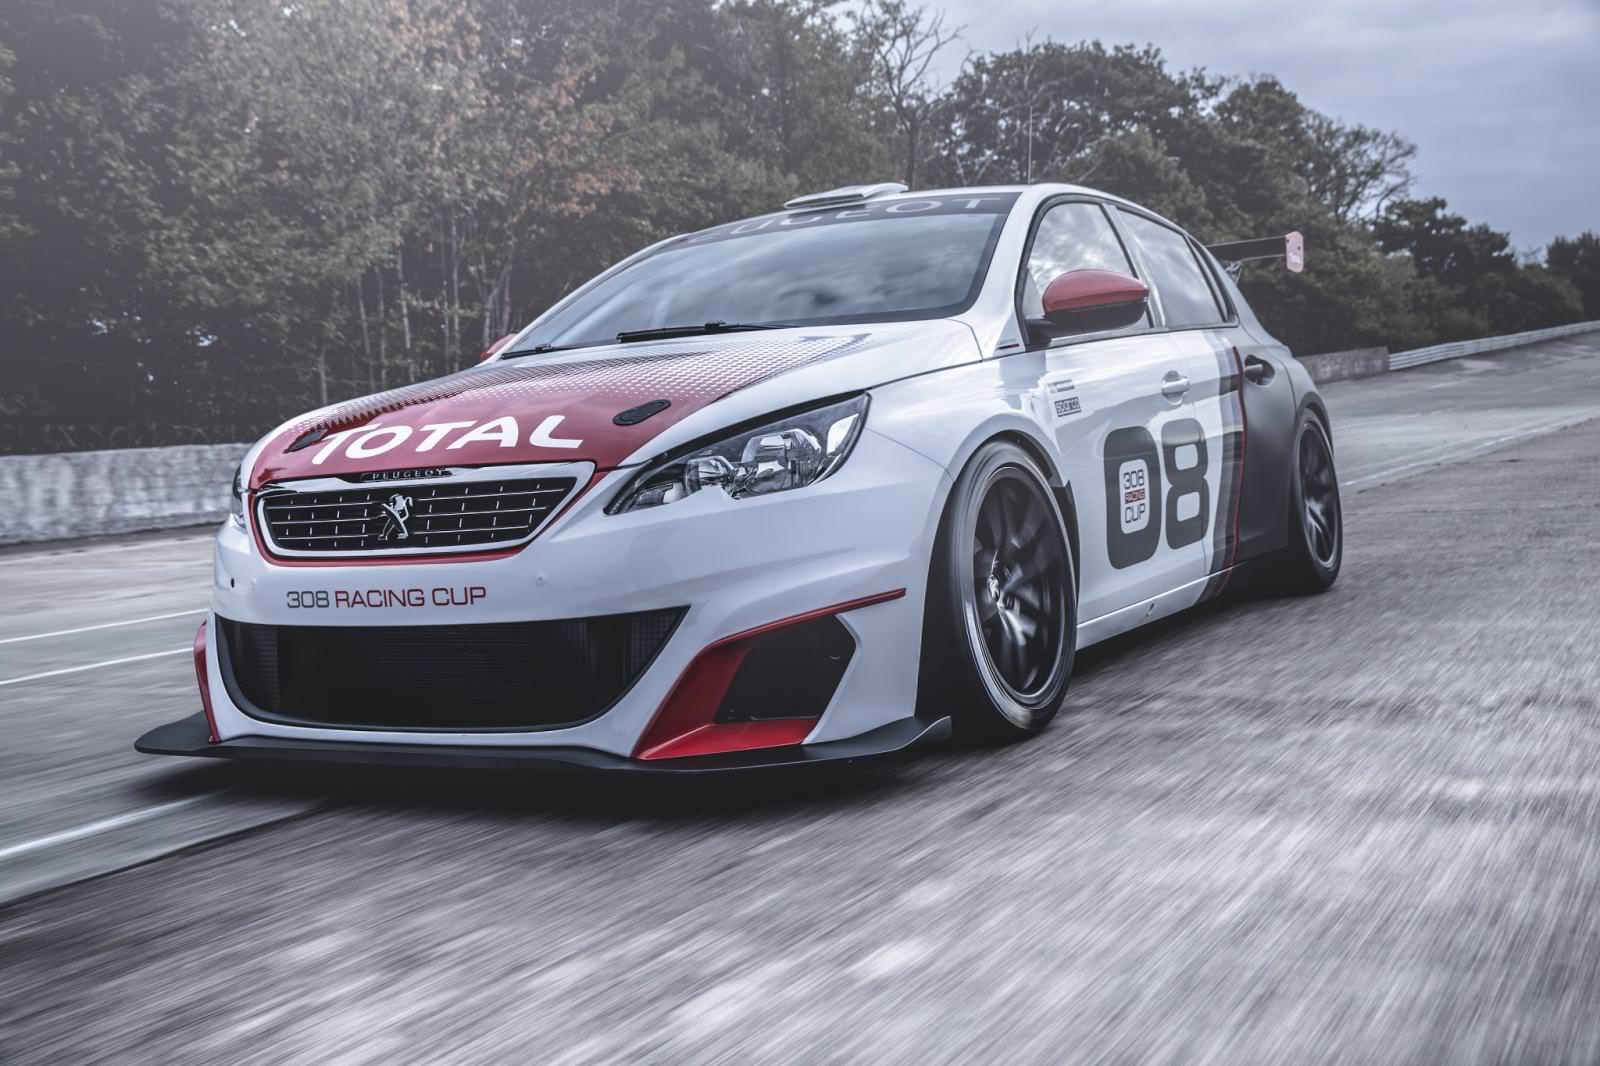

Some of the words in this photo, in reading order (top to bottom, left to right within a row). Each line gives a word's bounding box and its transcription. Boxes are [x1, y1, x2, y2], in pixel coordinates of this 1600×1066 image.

[311, 415, 584, 464] TOTAL
[372, 467, 447, 480] PEUGEOT
[1123, 469, 1145, 489] 308
[1103, 418, 1210, 570] 08
[1124, 503, 1146, 524] CUP
[286, 590, 330, 609] 308
[334, 588, 425, 608] RACING
[431, 586, 487, 607] CUP
